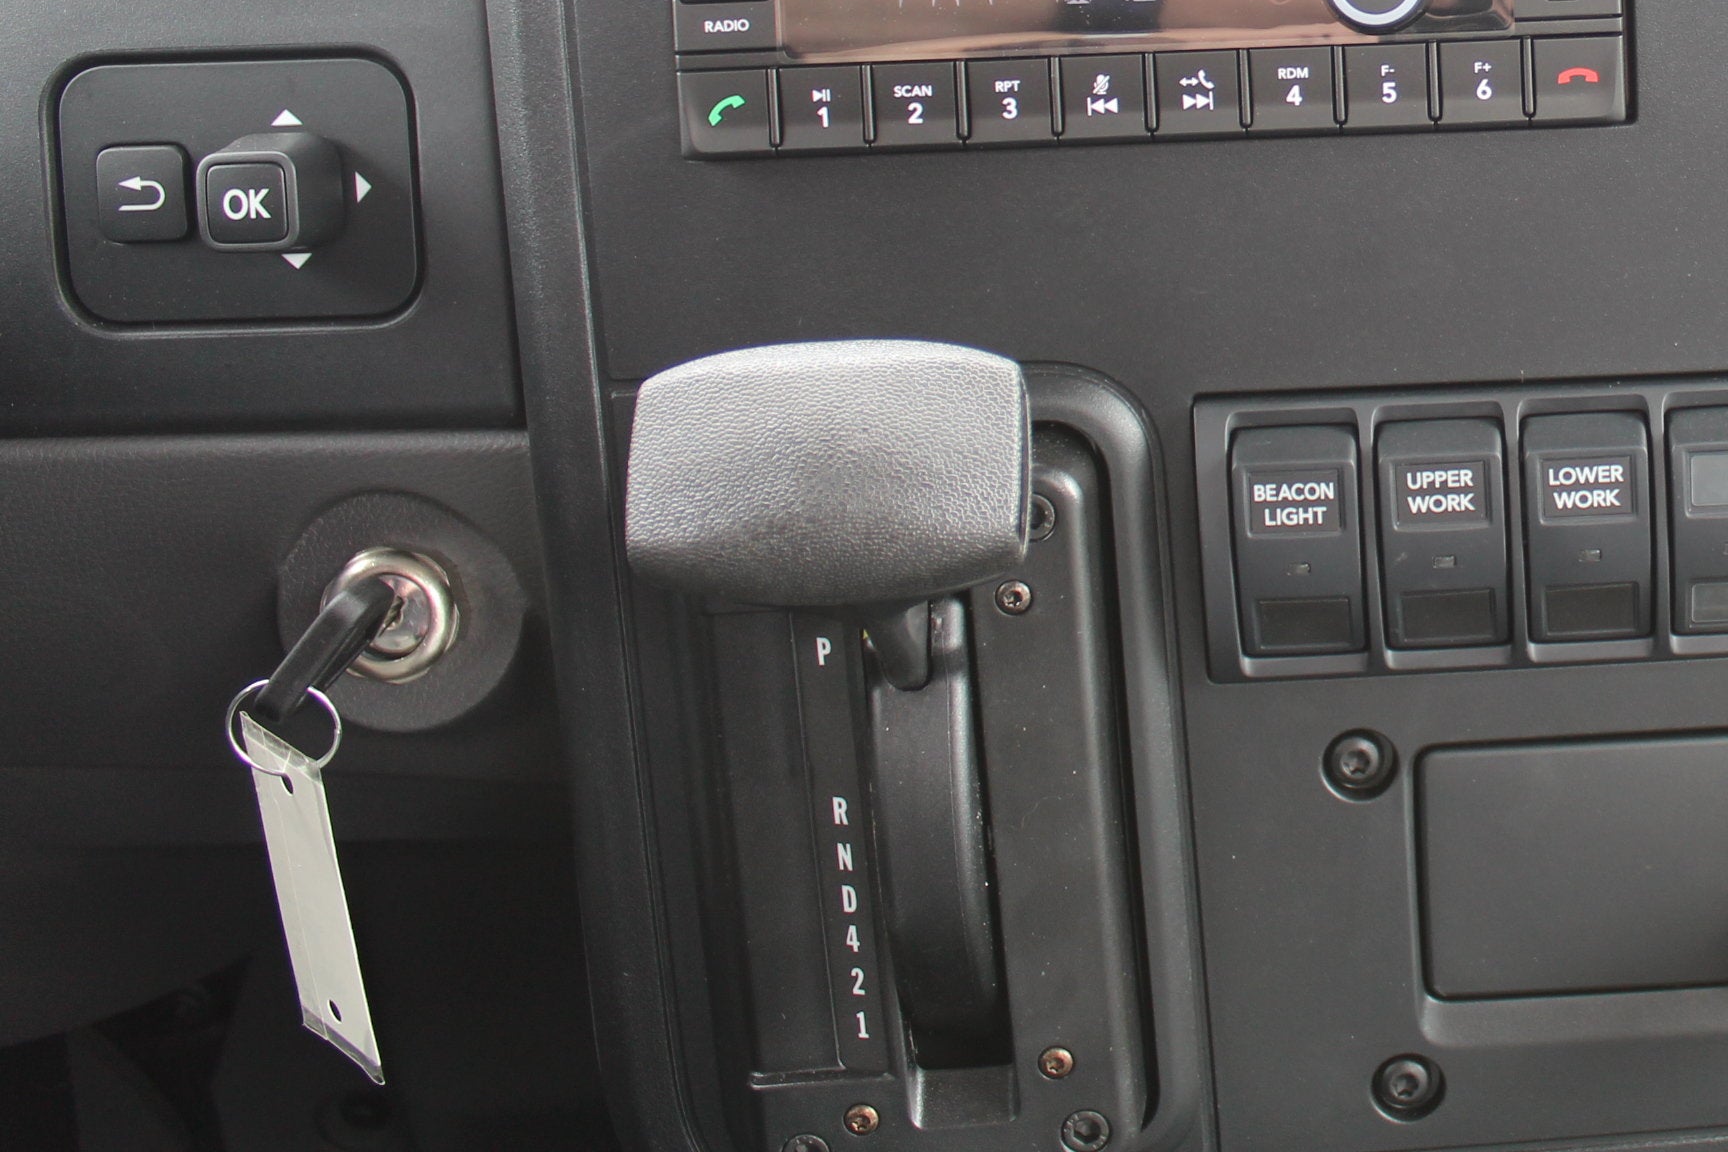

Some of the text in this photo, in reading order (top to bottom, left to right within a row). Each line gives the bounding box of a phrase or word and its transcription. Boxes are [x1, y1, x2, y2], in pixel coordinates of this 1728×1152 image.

[705, 19, 749, 32] RADIO
[1278, 67, 1308, 79] RDM
[1381, 65, 1394, 76] F-
[1475, 62, 1491, 73] F+
[894, 85, 932, 97] SCAN
[995, 80, 1020, 92] RPT
[1287, 85, 1302, 105] 4
[1382, 82, 1396, 103] 5
[1477, 79, 1491, 99] 6
[818, 107, 828, 127] 1
[908, 103, 923, 123] 2
[1003, 98, 1017, 119] 3
[223, 189, 269, 219] OK
[1407, 470, 1472, 489] UPPER
[1549, 465, 1623, 485] LOWER
[1254, 483, 1334, 501] BEACON
[1554, 489, 1619, 508] WORK
[1408, 494, 1474, 512] WORK
[1265, 507, 1326, 525] LIGHT
[817, 638, 831, 665] P
[833, 797, 848, 824] R
[837, 843, 852, 870] N
[842, 885, 856, 912] D
[847, 925, 860, 952] 4
[851, 968, 865, 995] 2
[857, 1012, 868, 1038] 1
